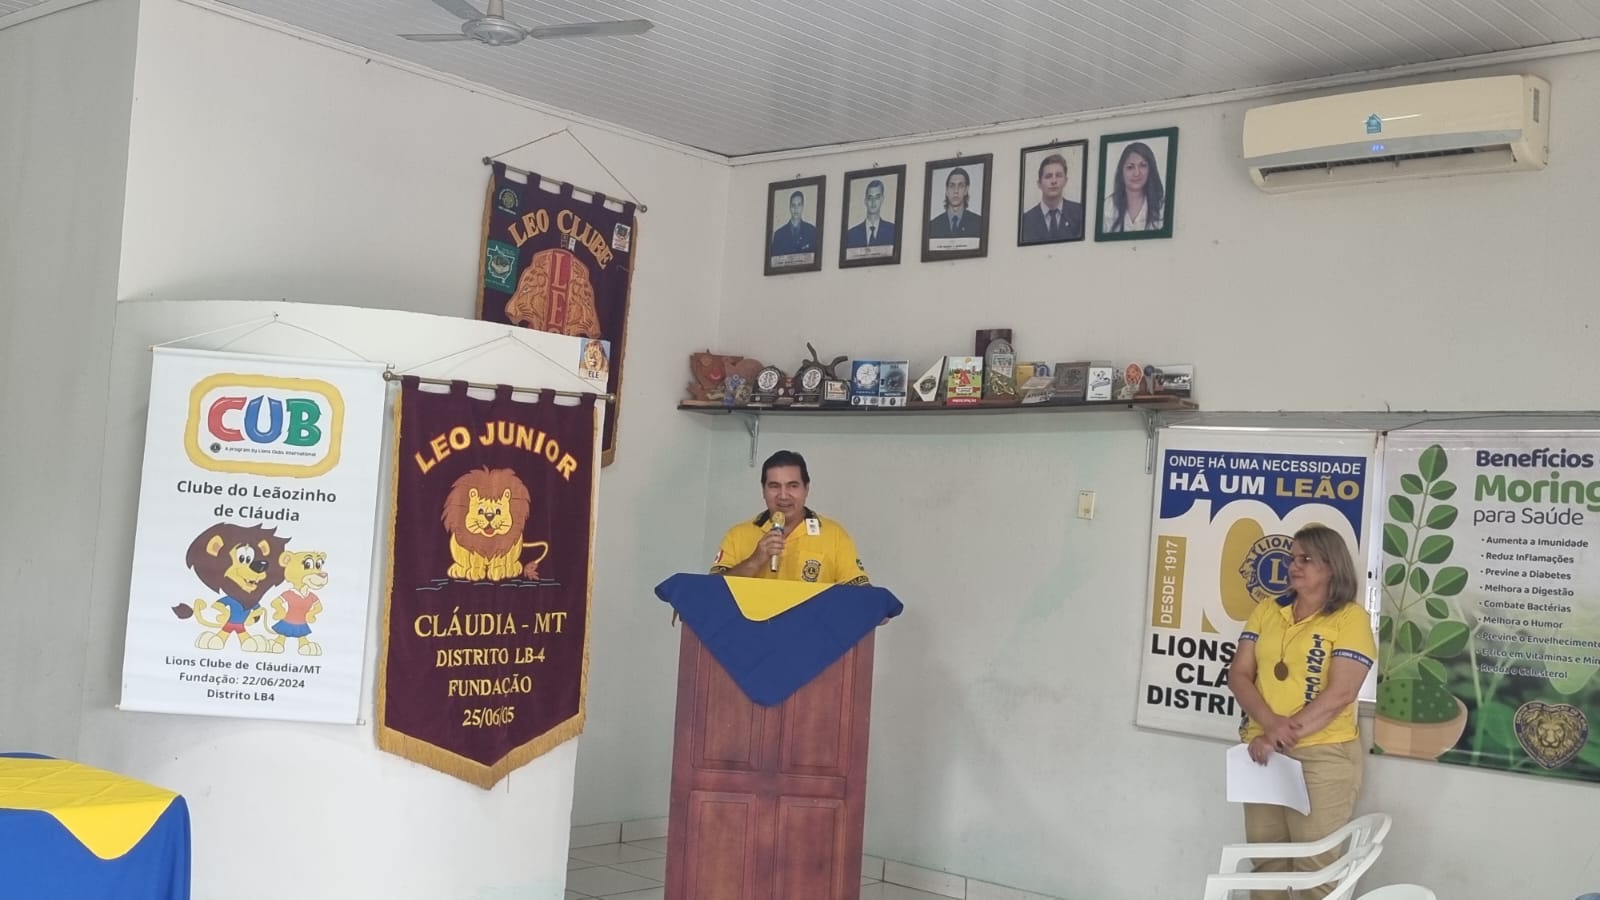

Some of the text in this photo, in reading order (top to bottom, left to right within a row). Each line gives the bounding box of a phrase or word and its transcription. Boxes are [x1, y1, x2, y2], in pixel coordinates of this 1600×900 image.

[508, 208, 550, 248] LEO
[557, 209, 614, 270] CLUBE
[208, 395, 322, 447] CUB
[414, 421, 578, 480] LEO JUNIOR
[1476, 448, 1594, 468] Benefícios
[1169, 455, 1361, 475] ONDE HÁ UMA NECESSIDADE
[176, 480, 336, 502] Clube do Leãozinho
[1169, 470, 1360, 500] HÁ UM LEÃO
[1474, 471, 1600, 512] Moring
[214, 504, 300, 522] de Cláudia
[1474, 506, 1584, 526] para Saúde
[1258, 538, 1294, 552] LION
[1486, 536, 1528, 545] Aumenta
[1538, 538, 1588, 548] Imunidade
[1486, 552, 1574, 564] Reduz Inflamações
[1160, 540, 1178, 624] DESDE 1917
[1486, 568, 1520, 577] Previne
[1530, 570, 1572, 580] Diabetes
[1484, 584, 1522, 594] Melhora
[1532, 587, 1574, 596] Digestão
[1484, 600, 1572, 613] Combate Bactérias
[414, 606, 516, 638] CLÁUDIA
[534, 612, 567, 634] MT
[1483, 616, 1520, 626] Melhora
[1530, 620, 1564, 629] Humor
[1482, 632, 1518, 642] Previne
[436, 647, 546, 667] DISTRITO LB-4
[1151, 633, 1237, 664] LIONS
[1526, 652, 1573, 663] Vitaminas
[1583, 657, 1600, 665] Min
[166, 656, 322, 674] Lions Clube de Cláudia/MT
[1176, 653, 1230, 688] CLÁ
[179, 672, 305, 688] Fundação: 22/06/2024
[448, 674, 532, 697] FUNDAÇÃO
[207, 688, 275, 702] Distrito LB4
[1147, 686, 1236, 716] DISTRI
[462, 706, 515, 728] 25/06/05
